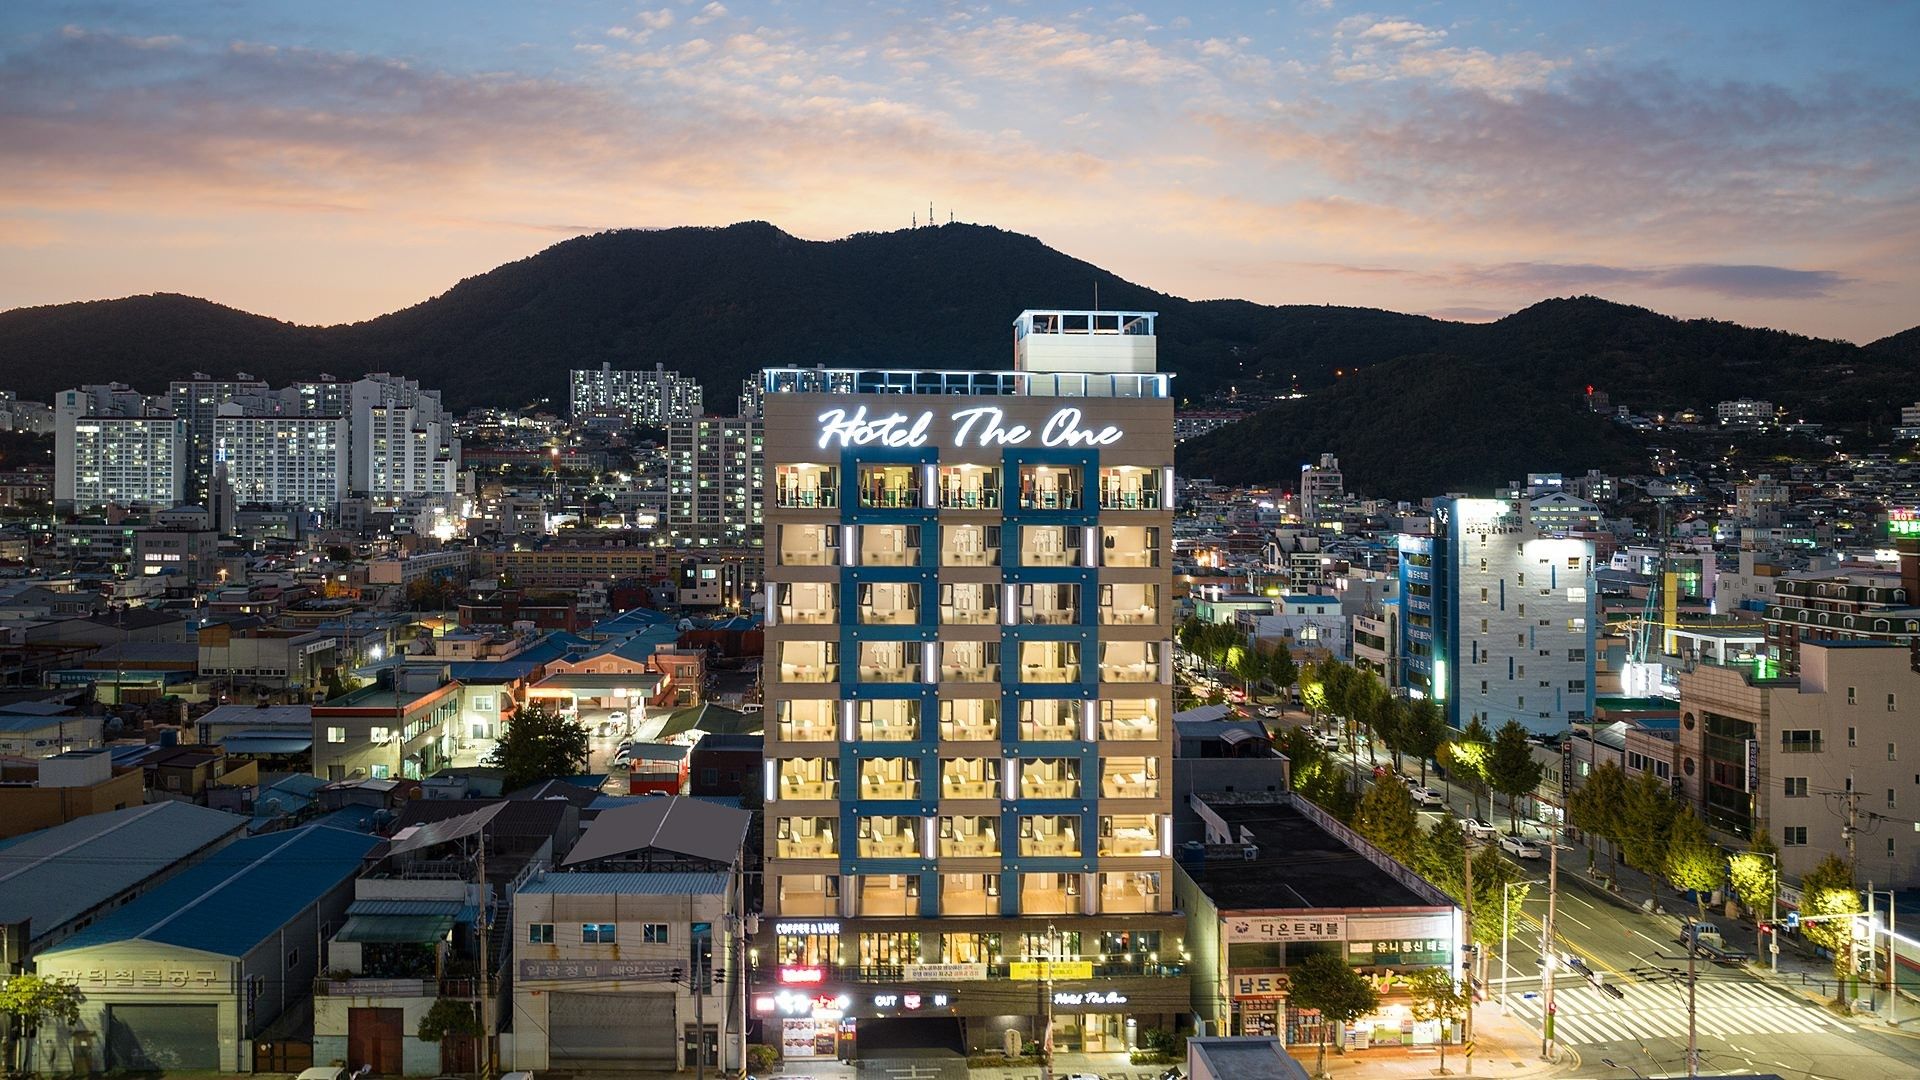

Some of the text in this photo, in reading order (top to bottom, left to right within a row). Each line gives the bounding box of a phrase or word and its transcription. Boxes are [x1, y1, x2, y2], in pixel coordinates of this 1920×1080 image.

[818, 405, 1124, 449] Hotel The One
[776, 923, 810, 935] COFFEE
[818, 922, 840, 934] LIVE
[1261, 922, 1339, 936] 다온트래블
[1240, 977, 1290, 995] 남도오
[874, 994, 897, 1007] OUT
